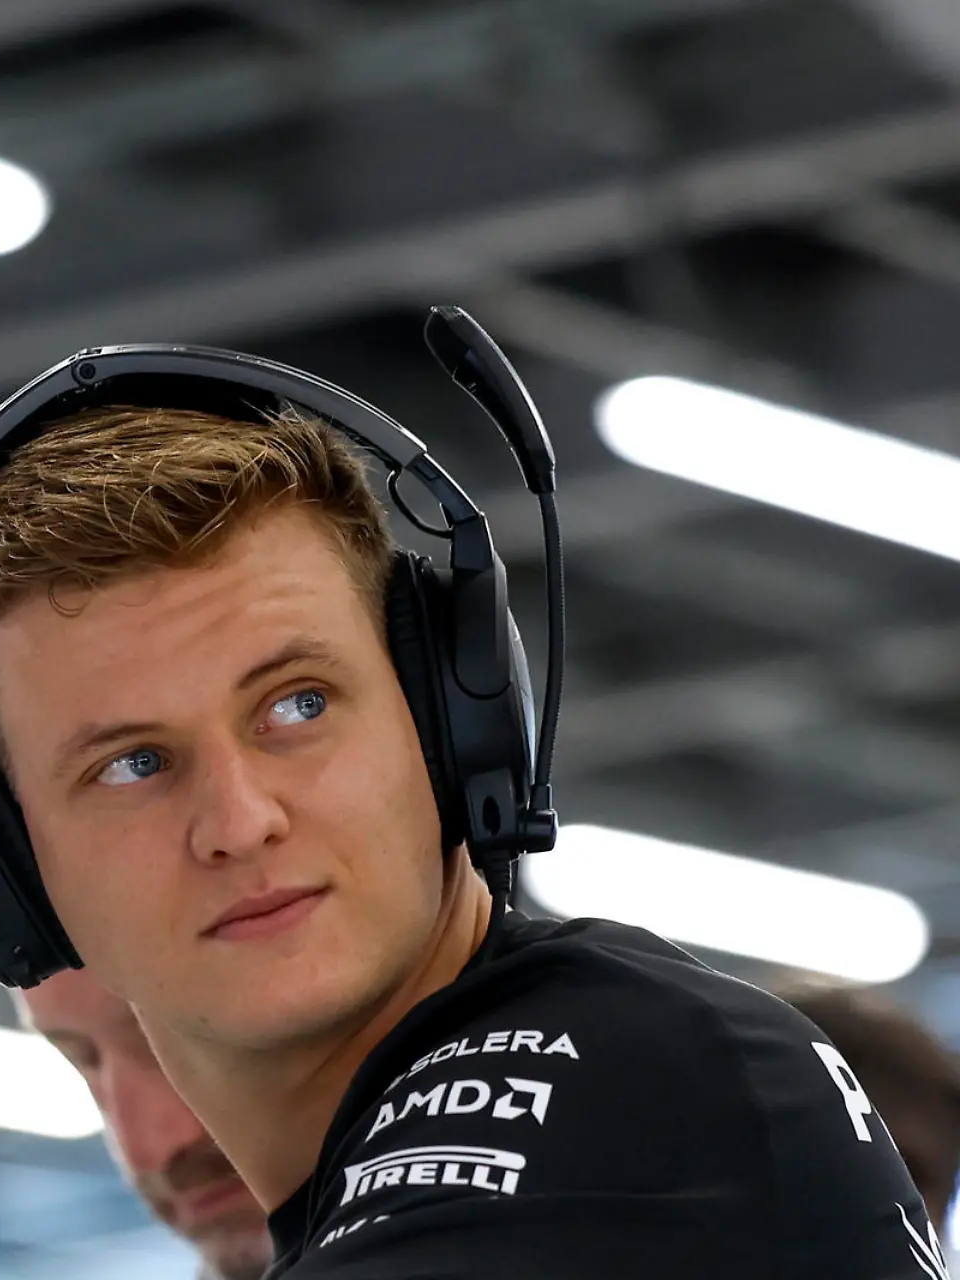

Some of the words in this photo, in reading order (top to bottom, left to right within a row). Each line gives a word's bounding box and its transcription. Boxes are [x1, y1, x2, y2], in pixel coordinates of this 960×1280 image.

[406, 1030, 580, 1078] SOLERA
[365, 1079, 491, 1143] AMD
[340, 1146, 527, 1206] PIRELLI
